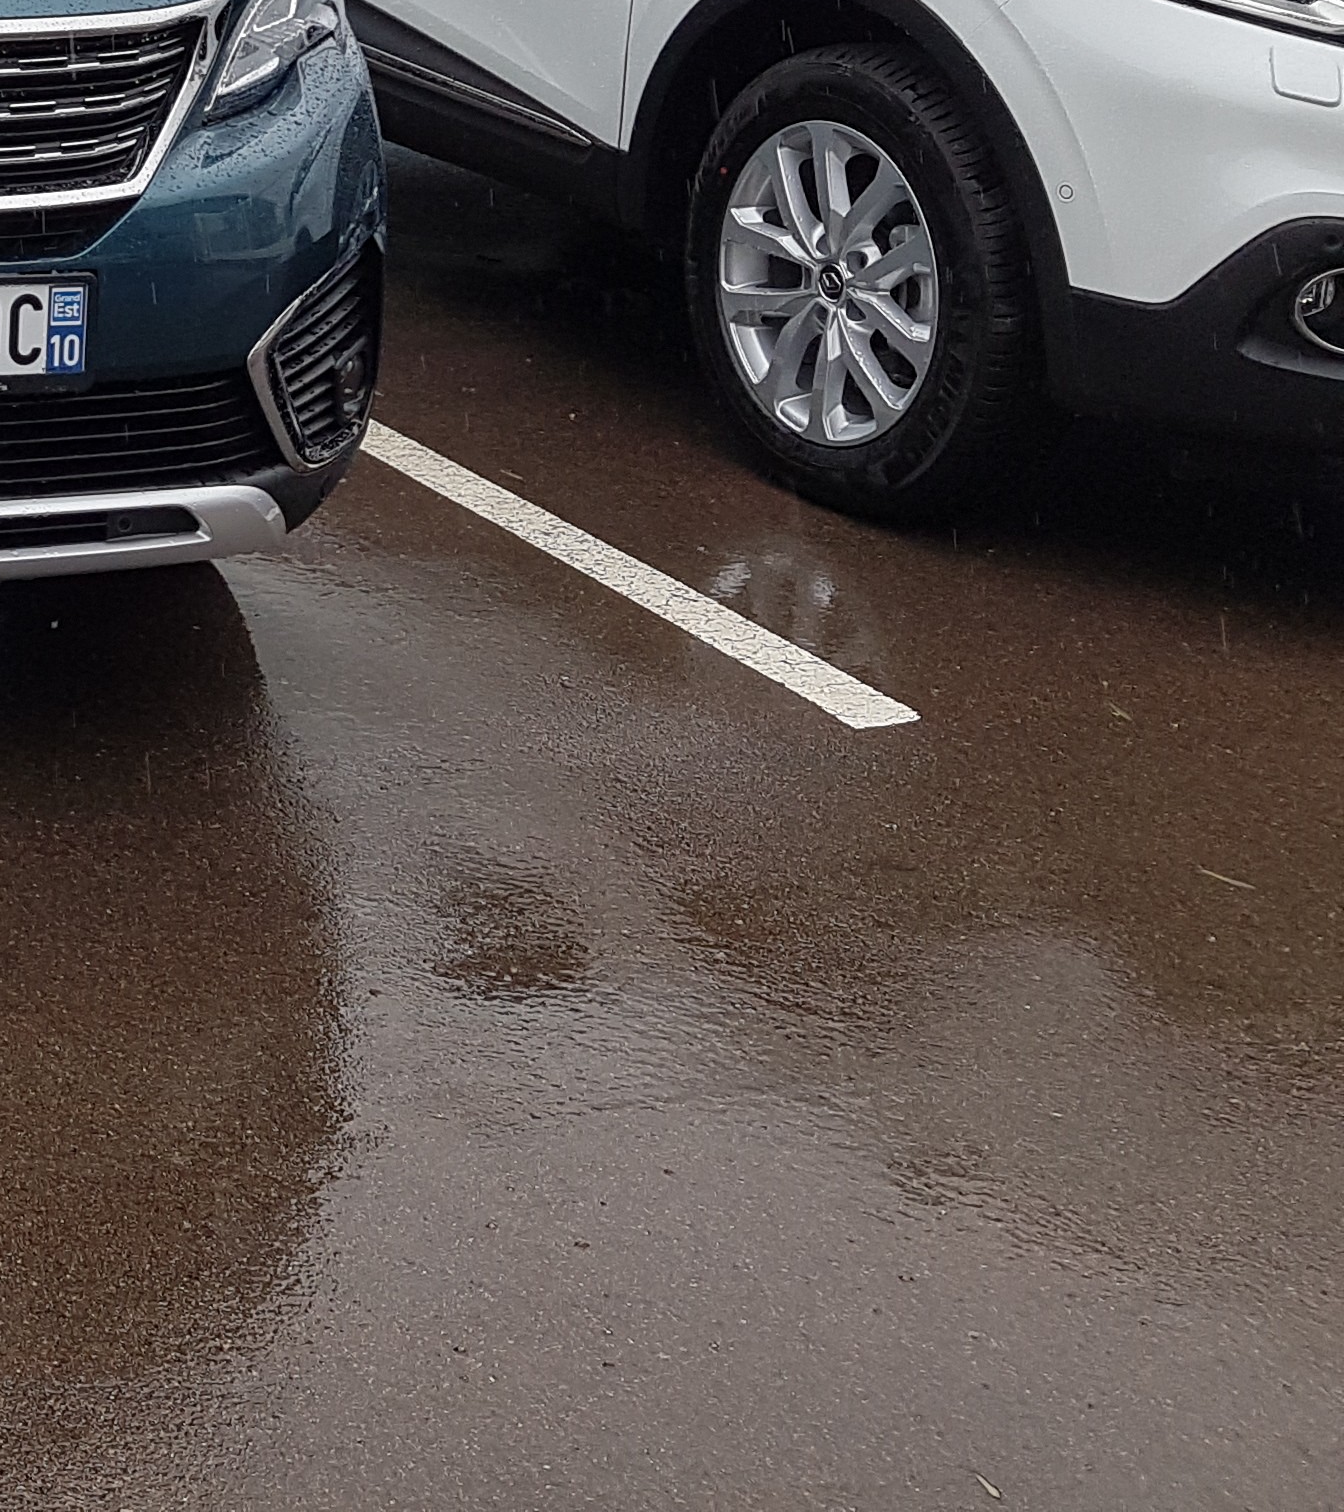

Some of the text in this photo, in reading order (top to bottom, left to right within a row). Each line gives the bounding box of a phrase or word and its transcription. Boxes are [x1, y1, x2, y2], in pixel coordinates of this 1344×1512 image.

[54, 293, 81, 303] Grand
[53, 302, 80, 318] Est
[50, 334, 80, 367] 10
